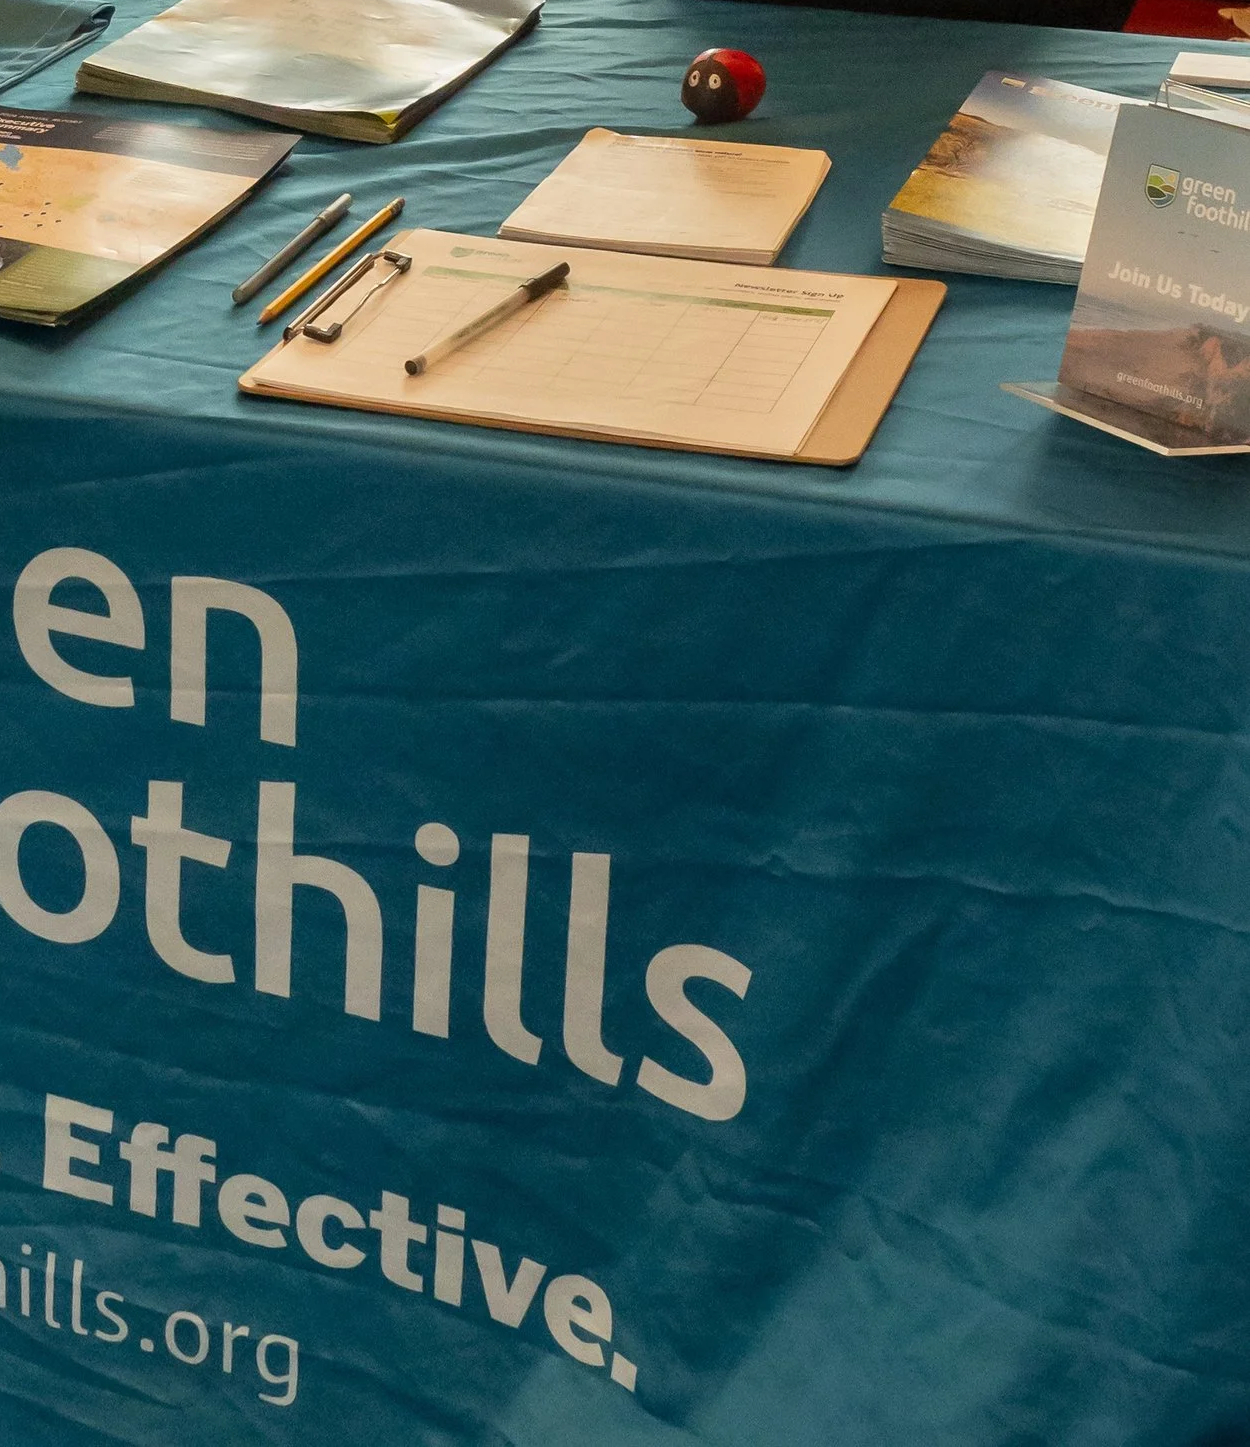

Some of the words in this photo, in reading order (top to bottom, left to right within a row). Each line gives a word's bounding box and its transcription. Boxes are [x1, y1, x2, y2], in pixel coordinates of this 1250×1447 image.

[1182, 176, 1237, 205] green
[734, 282, 798, 294] Newsletter
[801, 290, 825, 298] Sign
[1108, 261, 1150, 289] Join
[1156, 273, 1183, 299] Us
[1188, 282, 1250, 323] Today
[1116, 370, 1204, 409] greenfoothills.org
[42, 1091, 639, 1392] Effective.
